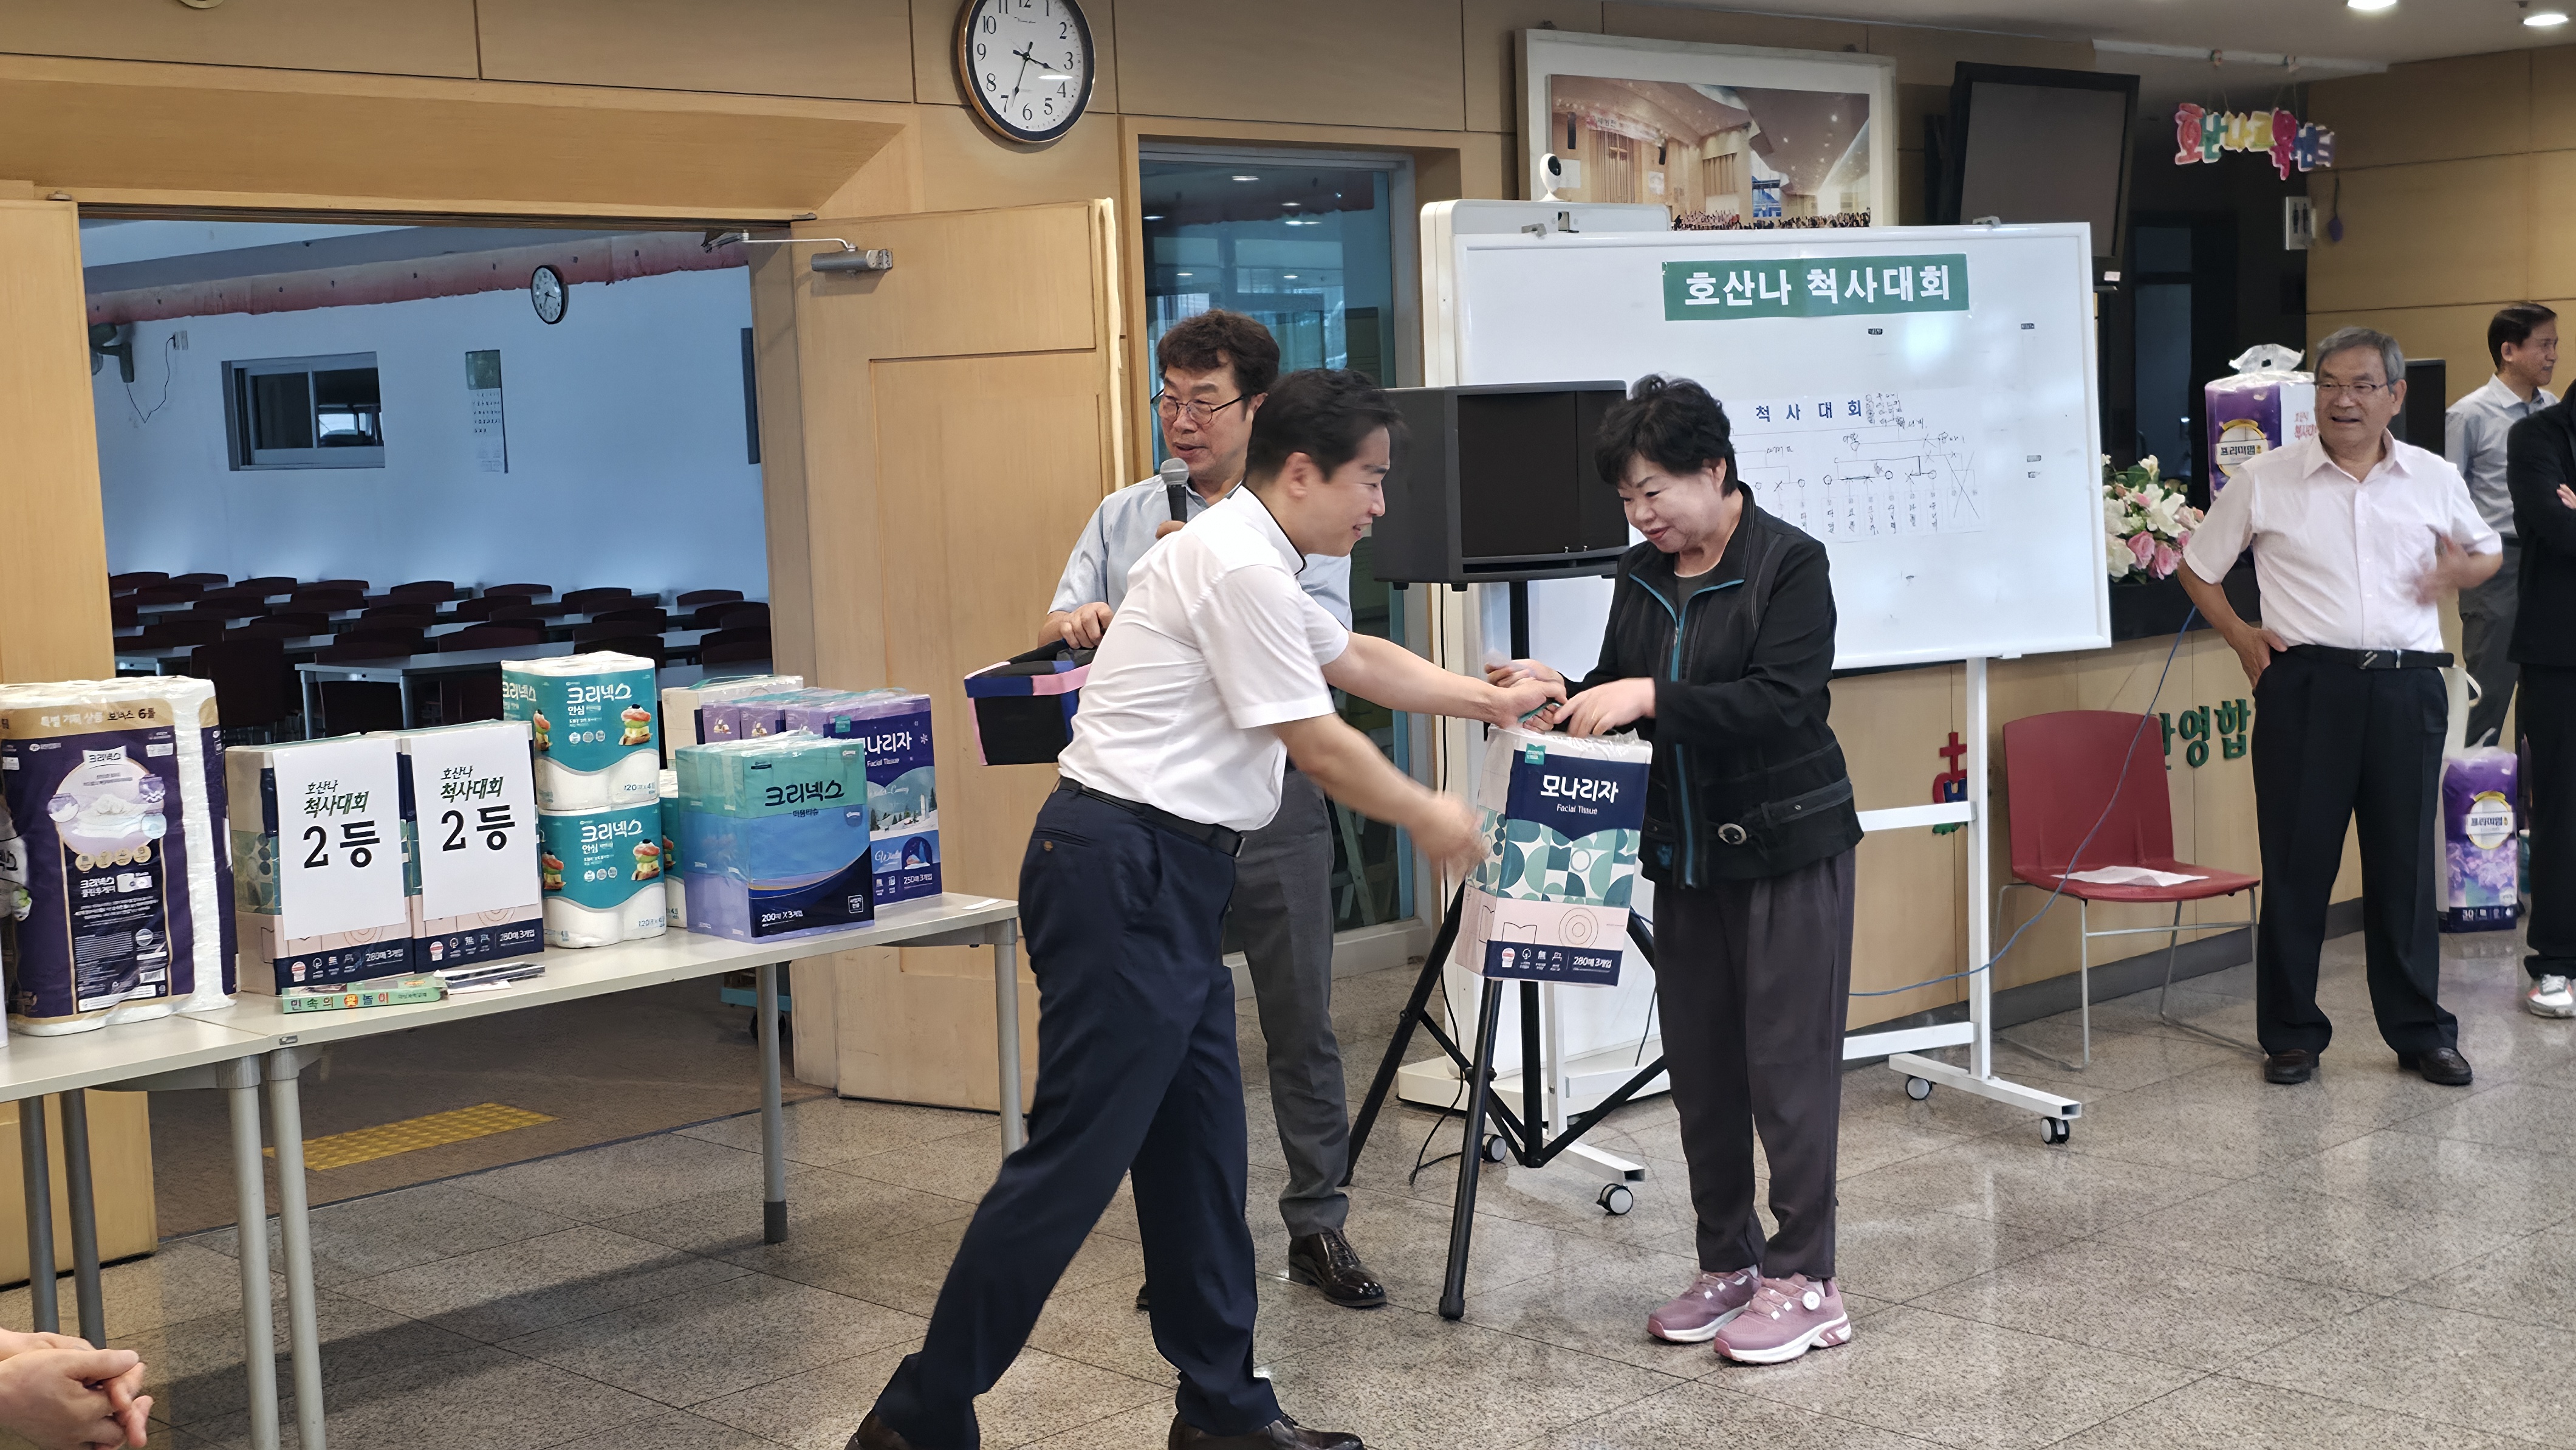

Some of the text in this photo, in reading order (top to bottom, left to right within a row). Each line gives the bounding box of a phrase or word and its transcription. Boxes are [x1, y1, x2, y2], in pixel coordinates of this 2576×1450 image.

[983, 15, 997, 34] 10
[1059, 22, 1067, 40] 2
[976, 43, 987, 61] 9
[1064, 52, 1074, 70] 3
[986, 73, 996, 92] 8
[1057, 81, 1066, 98] 4
[1001, 94, 1009, 113] 7
[1023, 103, 1033, 121] 6
[1044, 98, 1053, 115] 5
[1685, 265, 1950, 306] 호산나 척사대회
[566, 682, 632, 704] 크리넥스
[567, 705, 585, 716] 안심
[864, 731, 913, 755] 나리자
[440, 765, 473, 780] 호산나
[304, 778, 338, 795] 호산나
[440, 776, 504, 803] 척사대회
[765, 780, 845, 806] 크리넥스
[1540, 774, 1619, 803] 모나리자
[304, 791, 369, 818] 척사대회
[1557, 803, 1598, 815] Facial Tissue
[581, 819, 643, 842] 크리넥스
[582, 843, 598, 854] 안심
